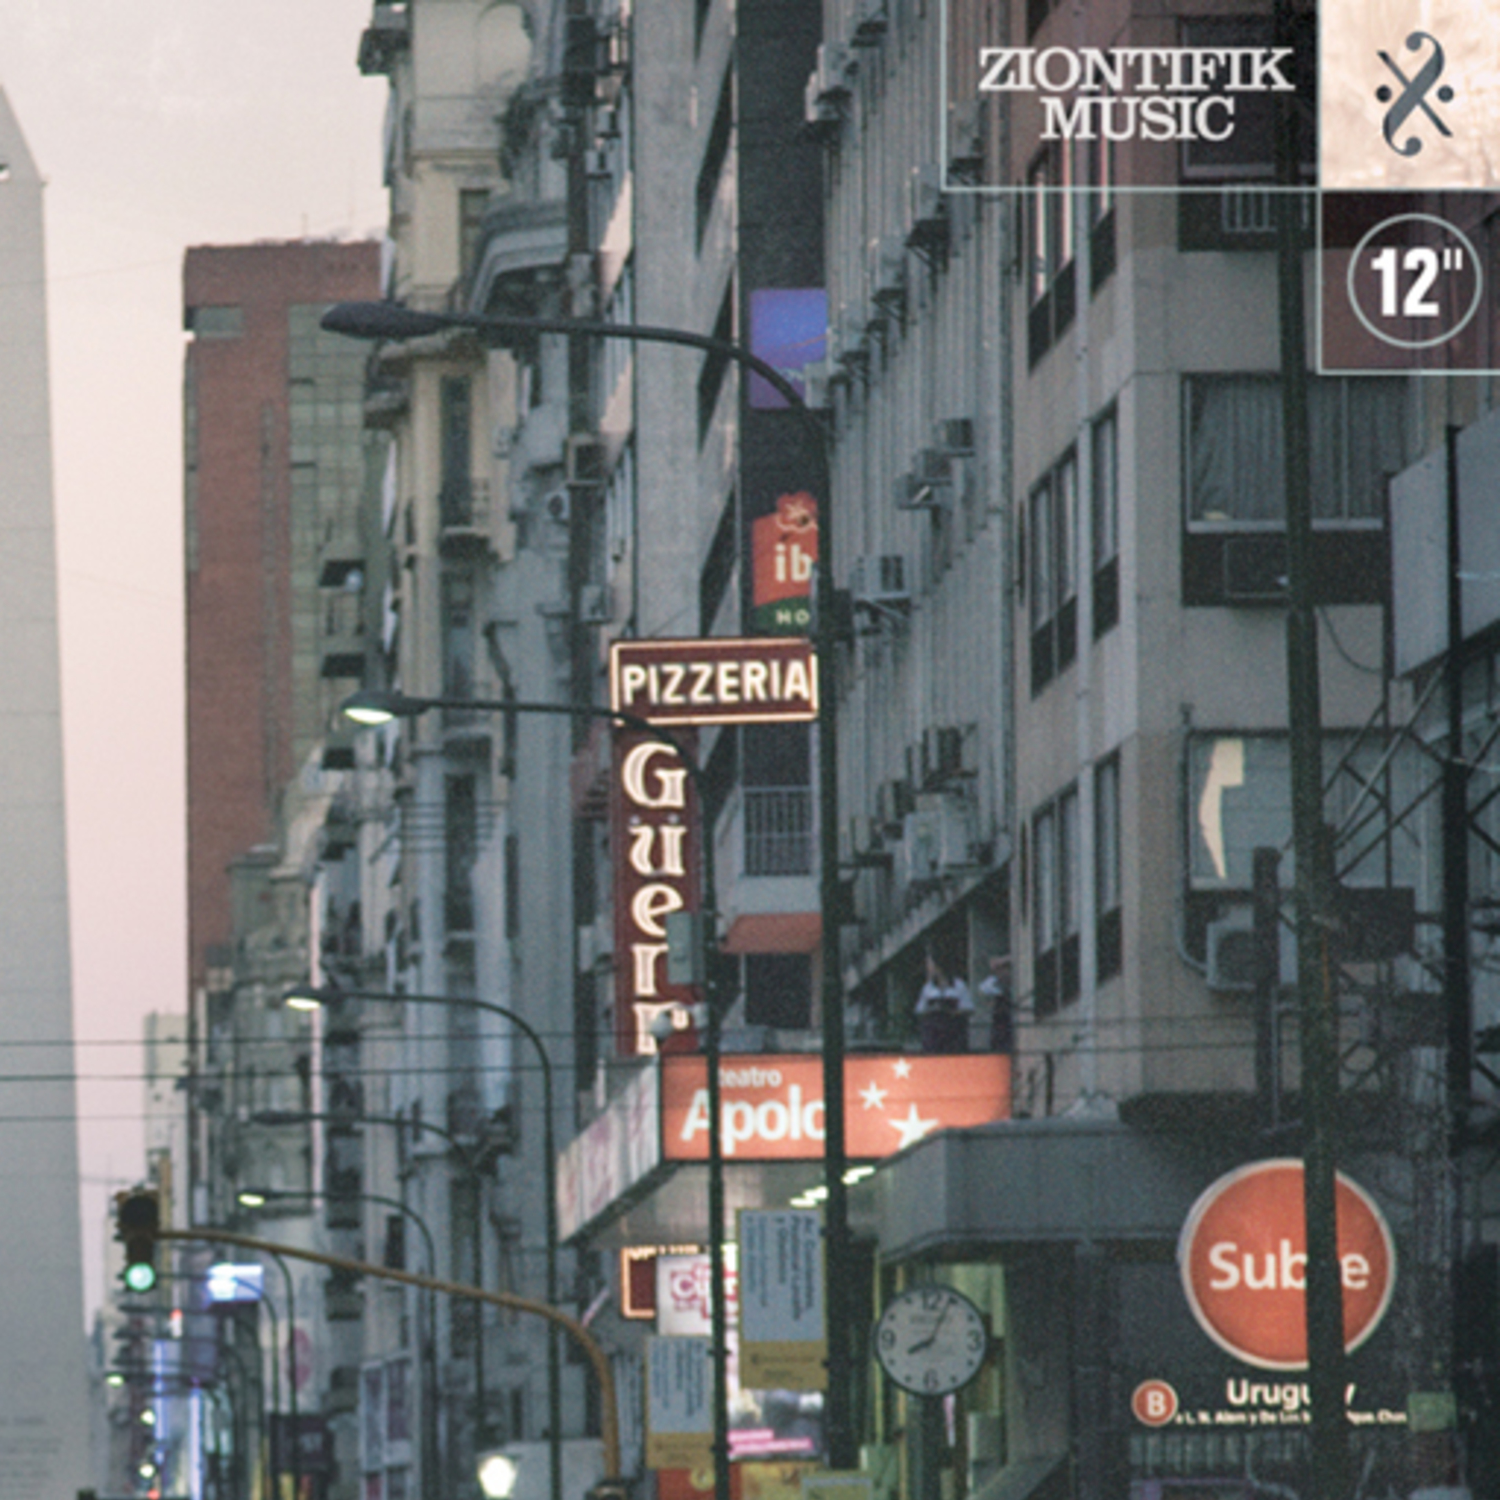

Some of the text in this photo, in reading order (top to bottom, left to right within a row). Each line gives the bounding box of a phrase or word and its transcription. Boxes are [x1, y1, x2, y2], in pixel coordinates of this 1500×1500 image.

[621, 659, 811, 706] PIZZERIA
[1208, 1238, 1371, 1291] Sube
[966, 1329, 981, 1353] 3
[1146, 1390, 1167, 1417] B
